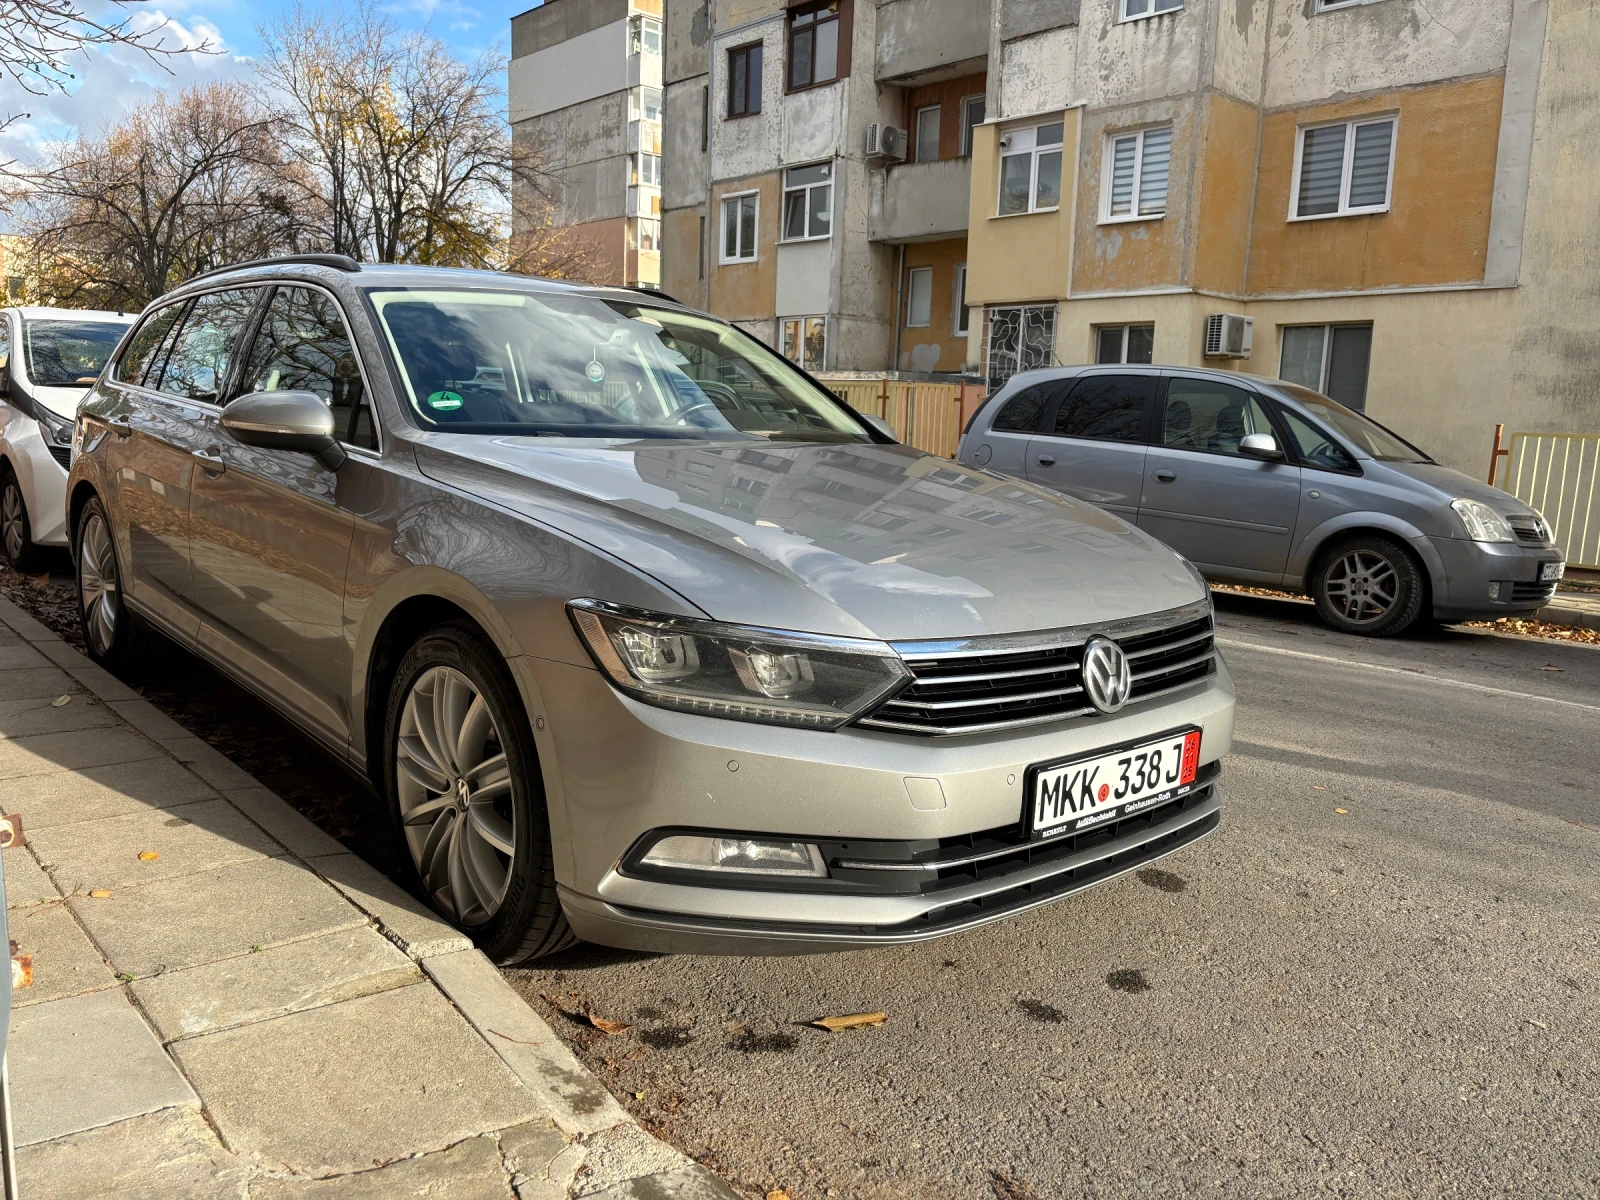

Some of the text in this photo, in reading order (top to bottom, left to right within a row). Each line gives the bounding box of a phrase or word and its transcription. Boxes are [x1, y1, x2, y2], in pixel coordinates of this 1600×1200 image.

[440, 391, 451, 401] 4
[1083, 637, 1131, 714] VW
[1038, 743, 1183, 822] MKK 338 J
